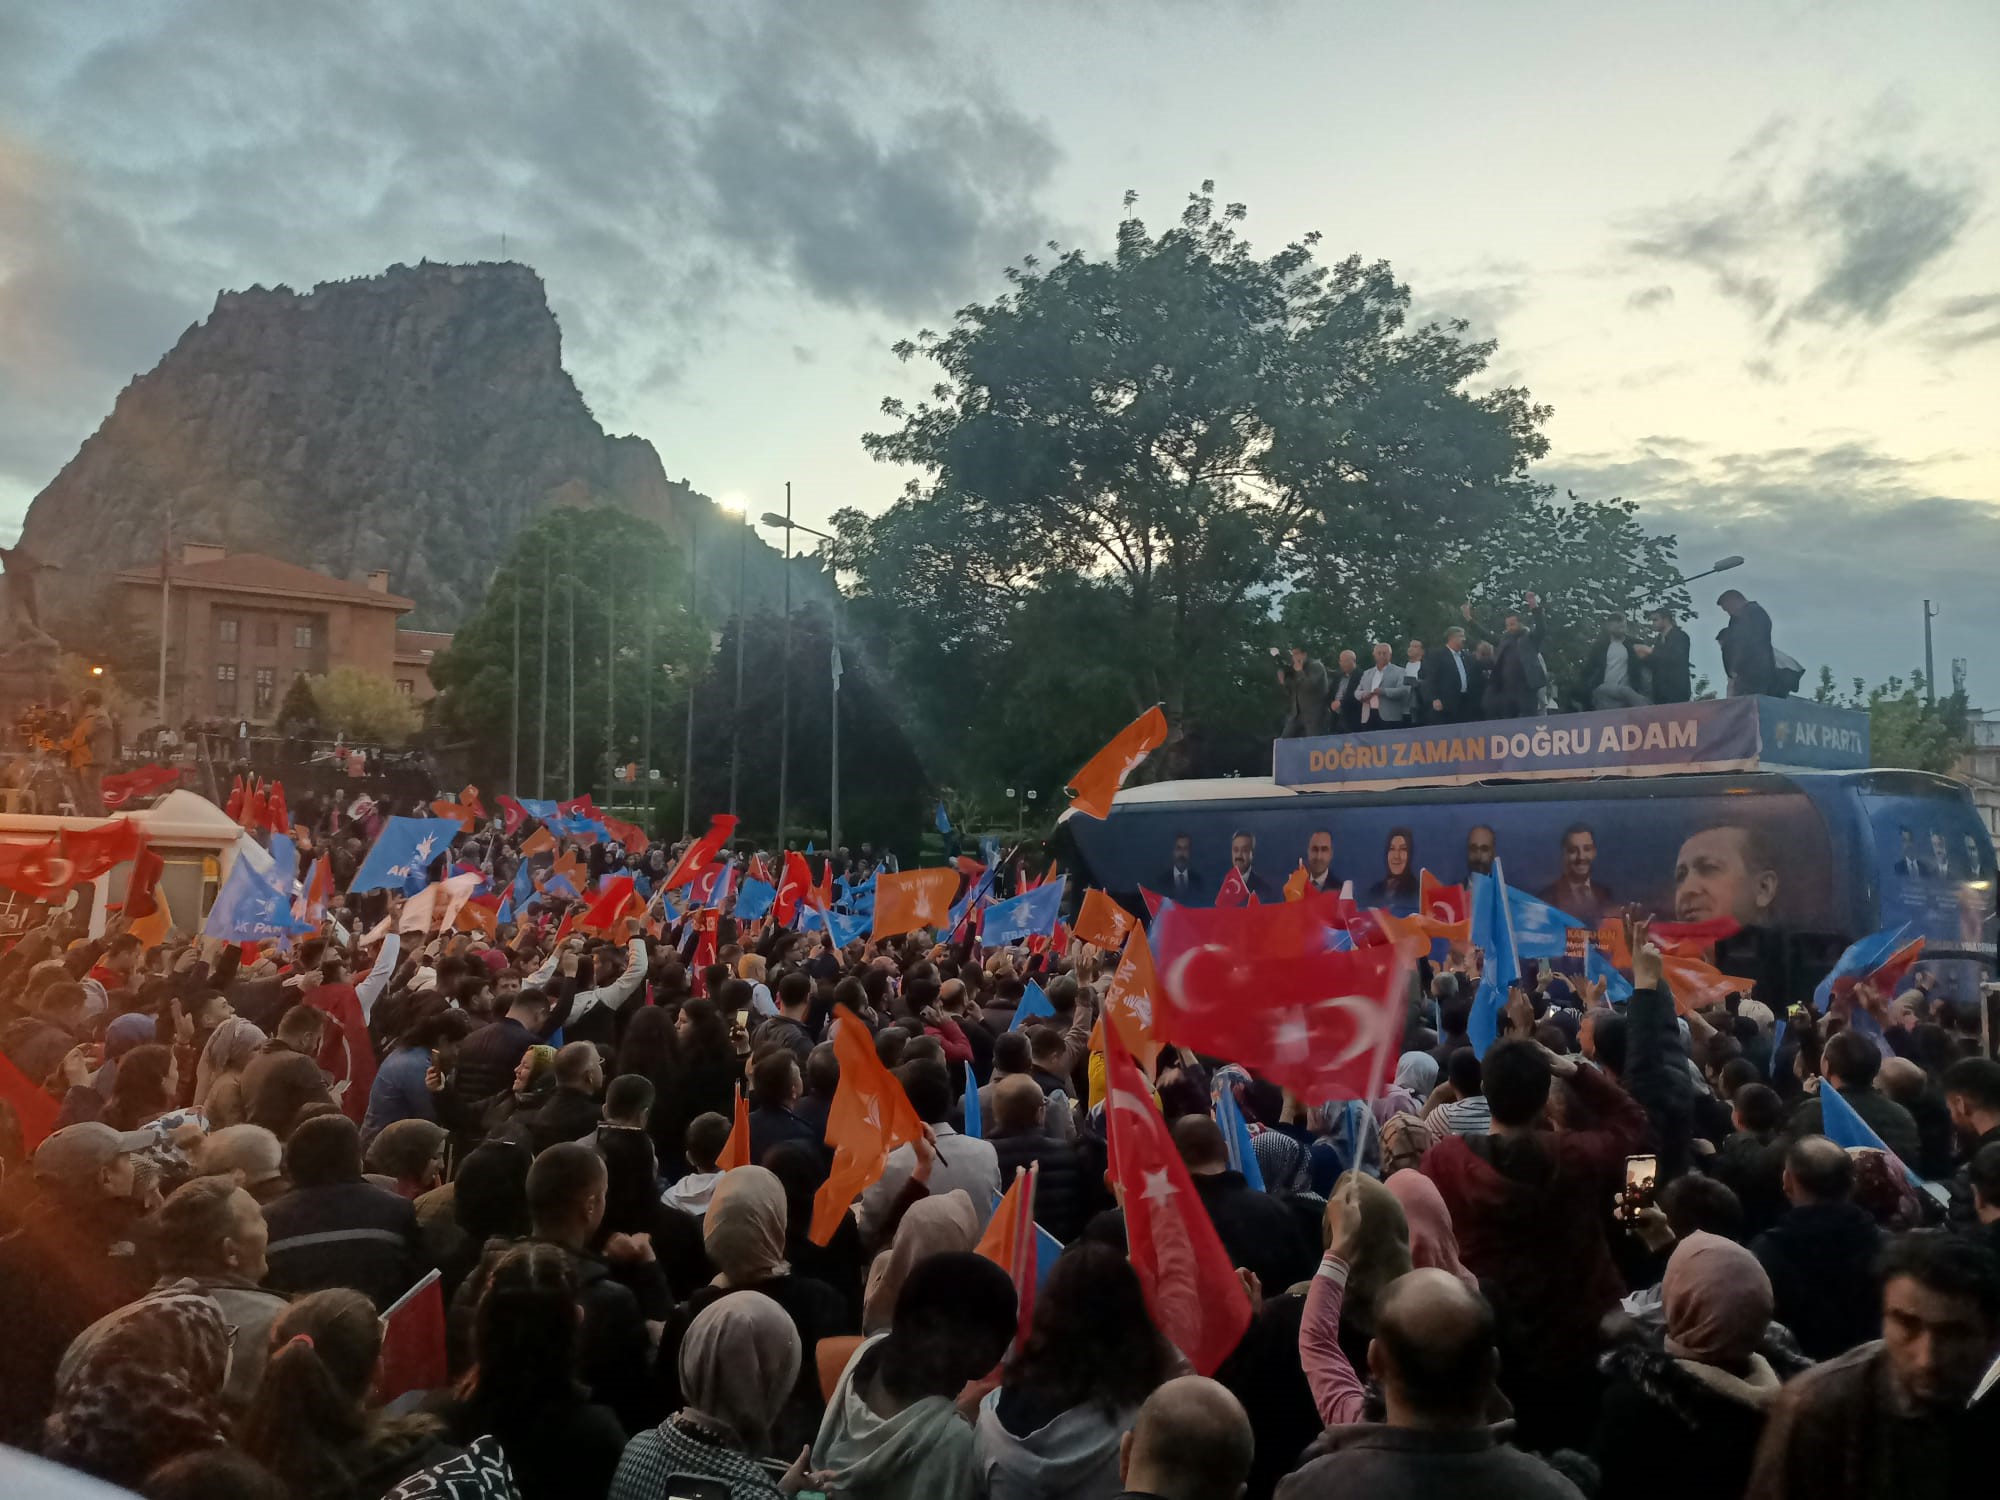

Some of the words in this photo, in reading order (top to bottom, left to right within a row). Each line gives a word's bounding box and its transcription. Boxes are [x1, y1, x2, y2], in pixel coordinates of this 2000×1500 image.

[1309, 742, 1388, 772] DOĞRU
[1393, 736, 1486, 767] ZAMAN
[1490, 724, 1591, 760] DOĞRU
[1598, 719, 1698, 753] ADAM
[1795, 720, 1819, 747] AK
[1117, 958, 1137, 983] AK
